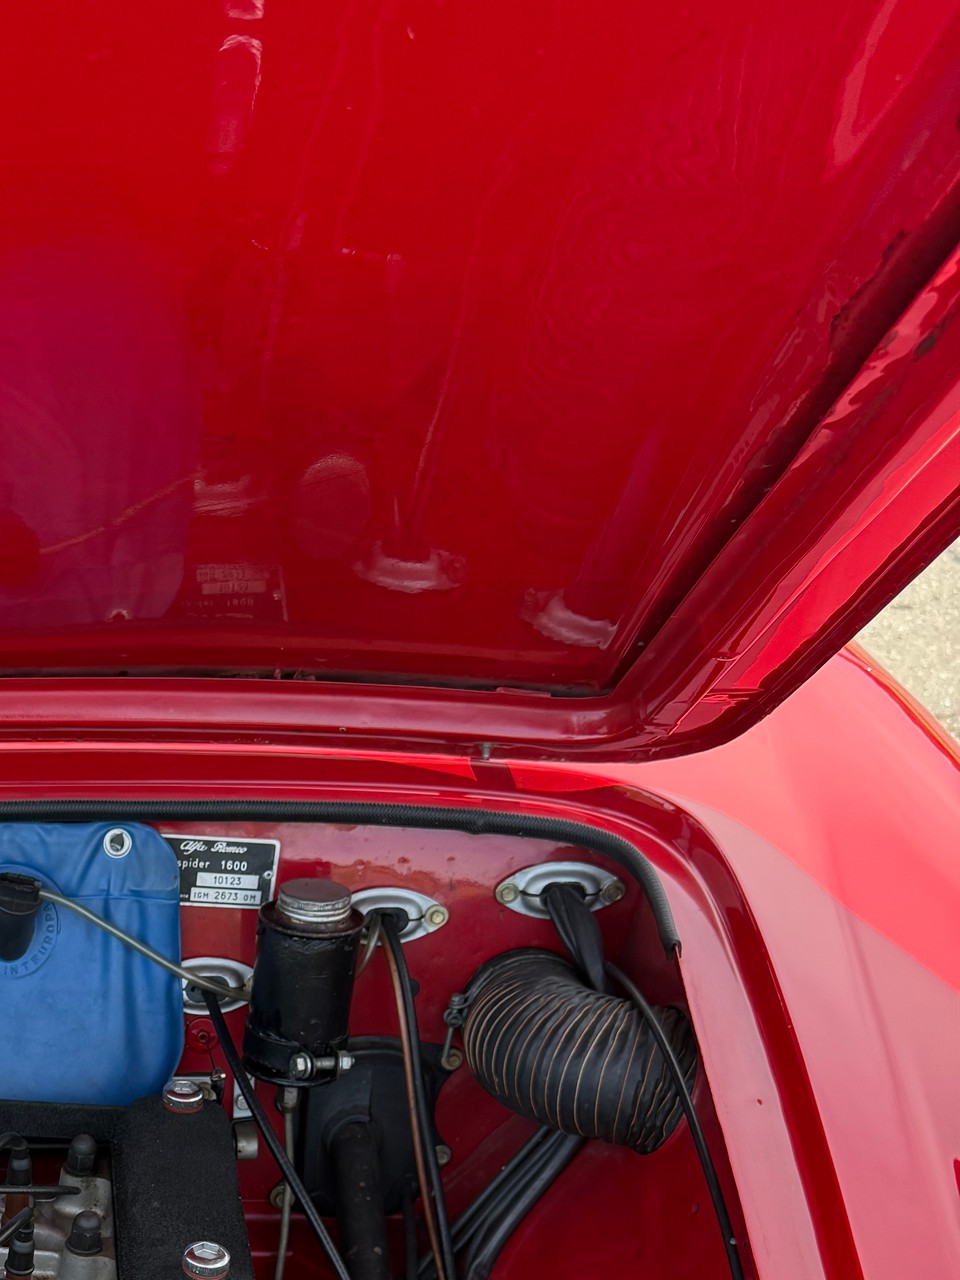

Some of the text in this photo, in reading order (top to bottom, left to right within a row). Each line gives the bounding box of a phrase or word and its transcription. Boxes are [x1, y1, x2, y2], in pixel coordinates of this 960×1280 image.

[180, 840, 248, 855] Alfa Romeo
[221, 860, 248, 871] 1600
[213, 875, 242, 886] 10123
[214, 890, 239, 901] 2673
